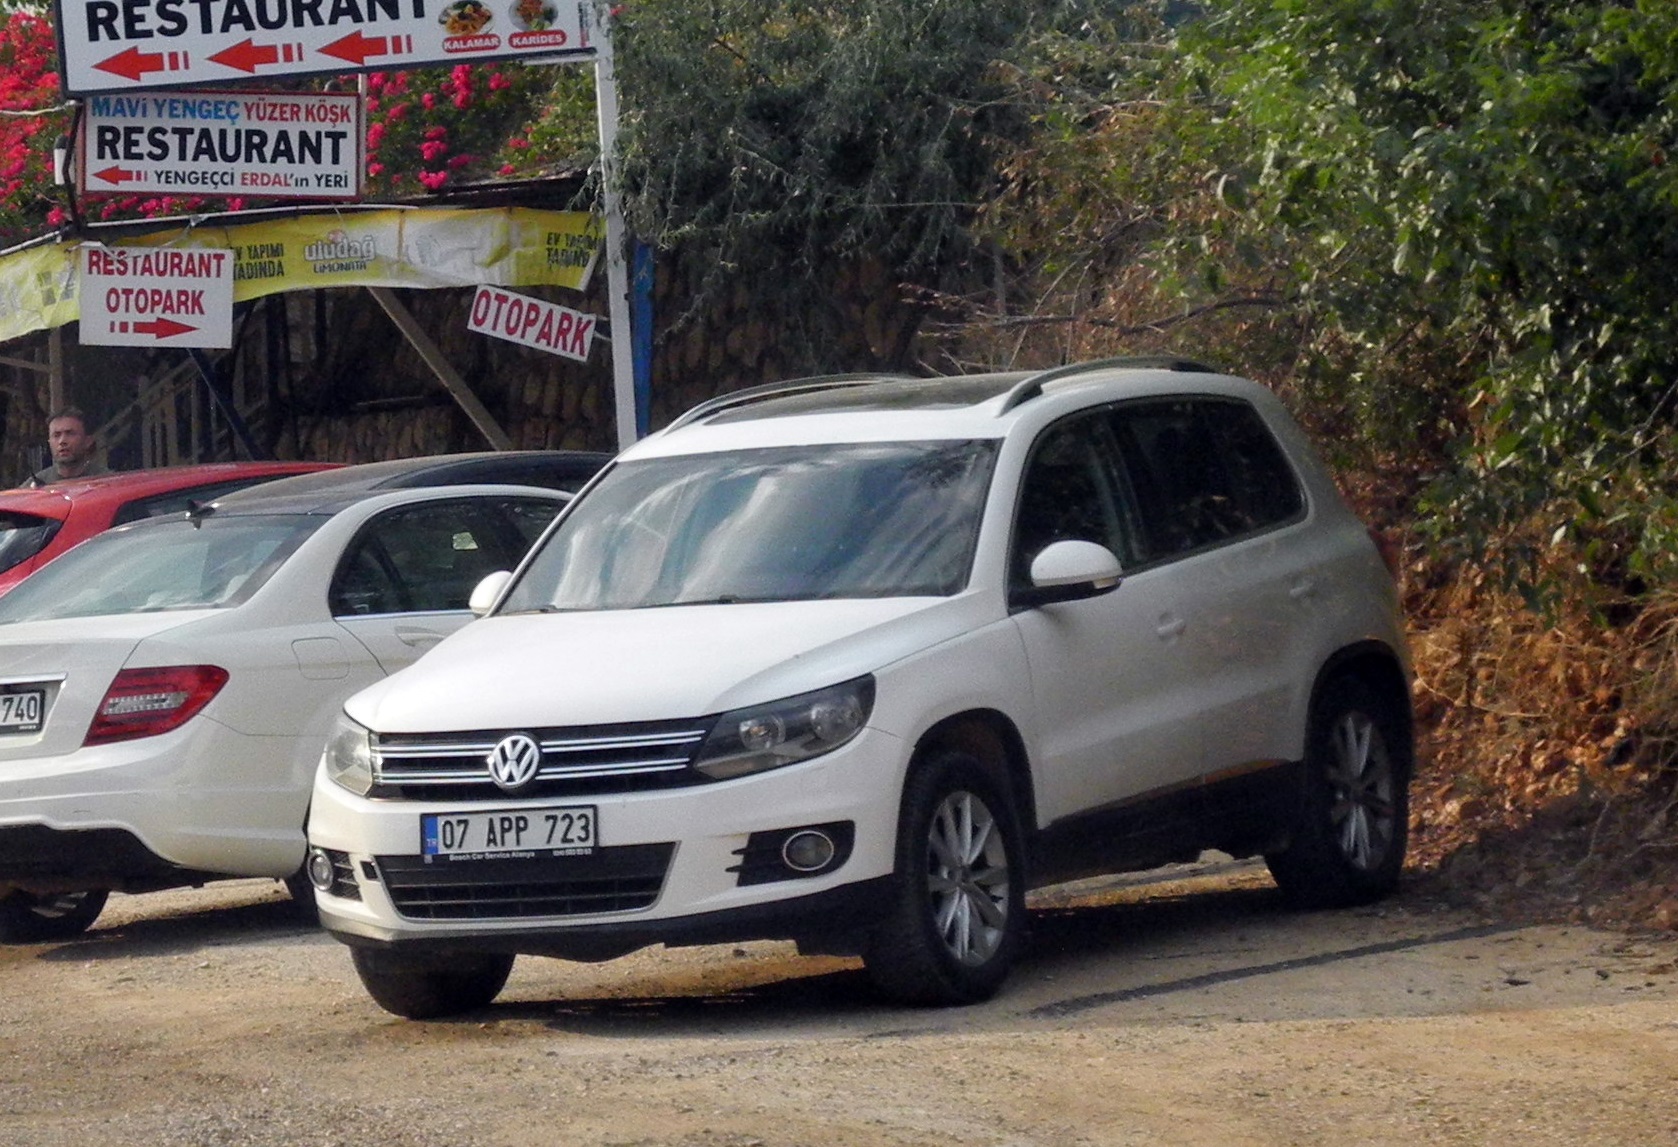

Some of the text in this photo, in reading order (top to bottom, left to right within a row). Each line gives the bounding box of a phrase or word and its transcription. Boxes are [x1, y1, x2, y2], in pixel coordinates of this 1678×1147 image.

[443, 37, 499, 50] KALAMAR
[153, 98, 240, 125] YENGEÇ
[244, 98, 300, 123] YÜZER
[305, 99, 351, 128] KÖŞK
[97, 125, 347, 165] RESTAURANT
[154, 167, 234, 190] YENGEÇCİ
[314, 170, 348, 188] YERİ
[247, 243, 284, 260] YAPIMI
[304, 234, 377, 261] uludağ
[87, 249, 225, 278] RESTAURANT
[105, 288, 205, 315] OTOPARK
[472, 289, 593, 357] OTOPARK
[2, 695, 38, 723] 740
[442, 813, 590, 849] 07 APP 723
